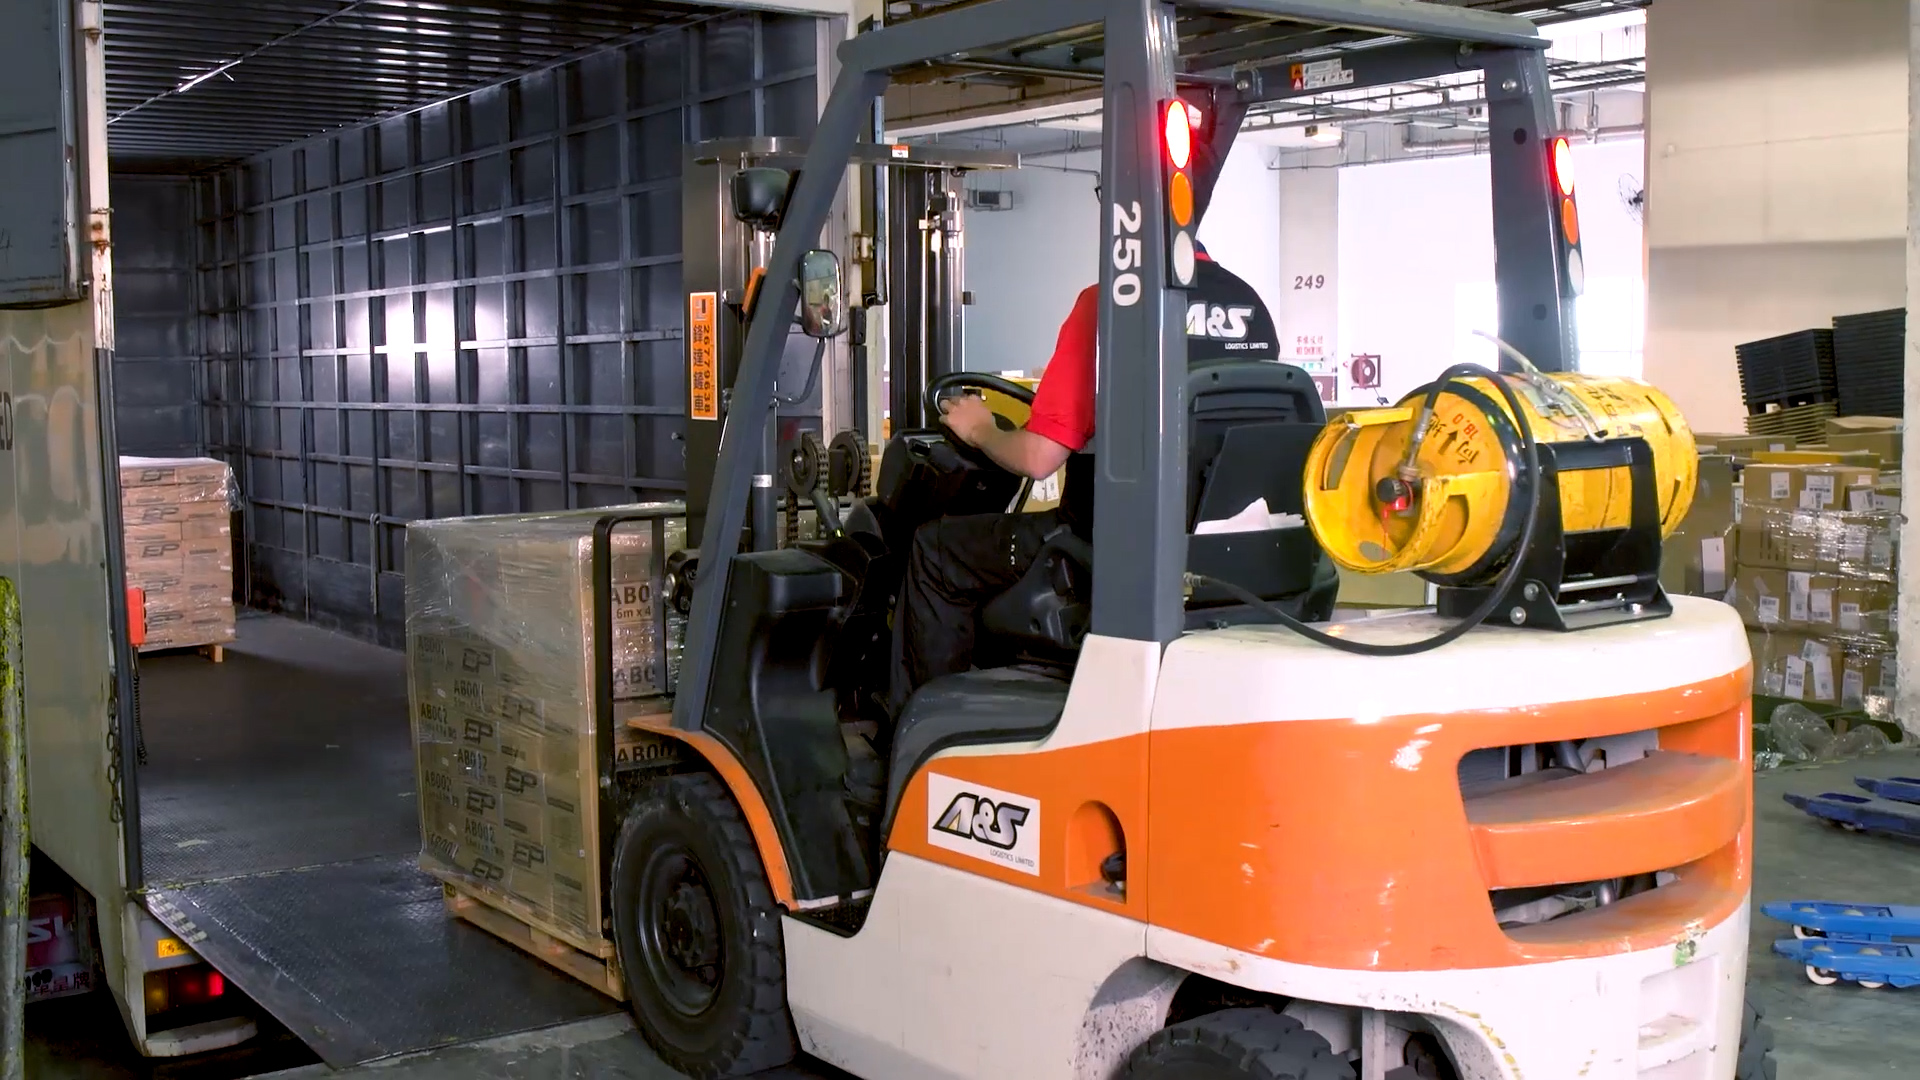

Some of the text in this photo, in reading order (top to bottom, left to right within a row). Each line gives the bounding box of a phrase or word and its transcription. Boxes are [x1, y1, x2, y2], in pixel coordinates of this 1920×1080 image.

[1113, 201, 1142, 306] 250
[1294, 274, 1325, 290] 249
[1186, 302, 1254, 340] A&S
[142, 543, 180, 558] EP
[616, 606, 652, 619] 6m x 4
[463, 718, 494, 744] EP
[505, 765, 538, 794] EP
[466, 787, 496, 815] EP
[932, 792, 1030, 850] A&S
[512, 839, 545, 868] EP
[990, 849, 1035, 868] LOGISTICS LIMITED
[472, 857, 504, 881] EP
